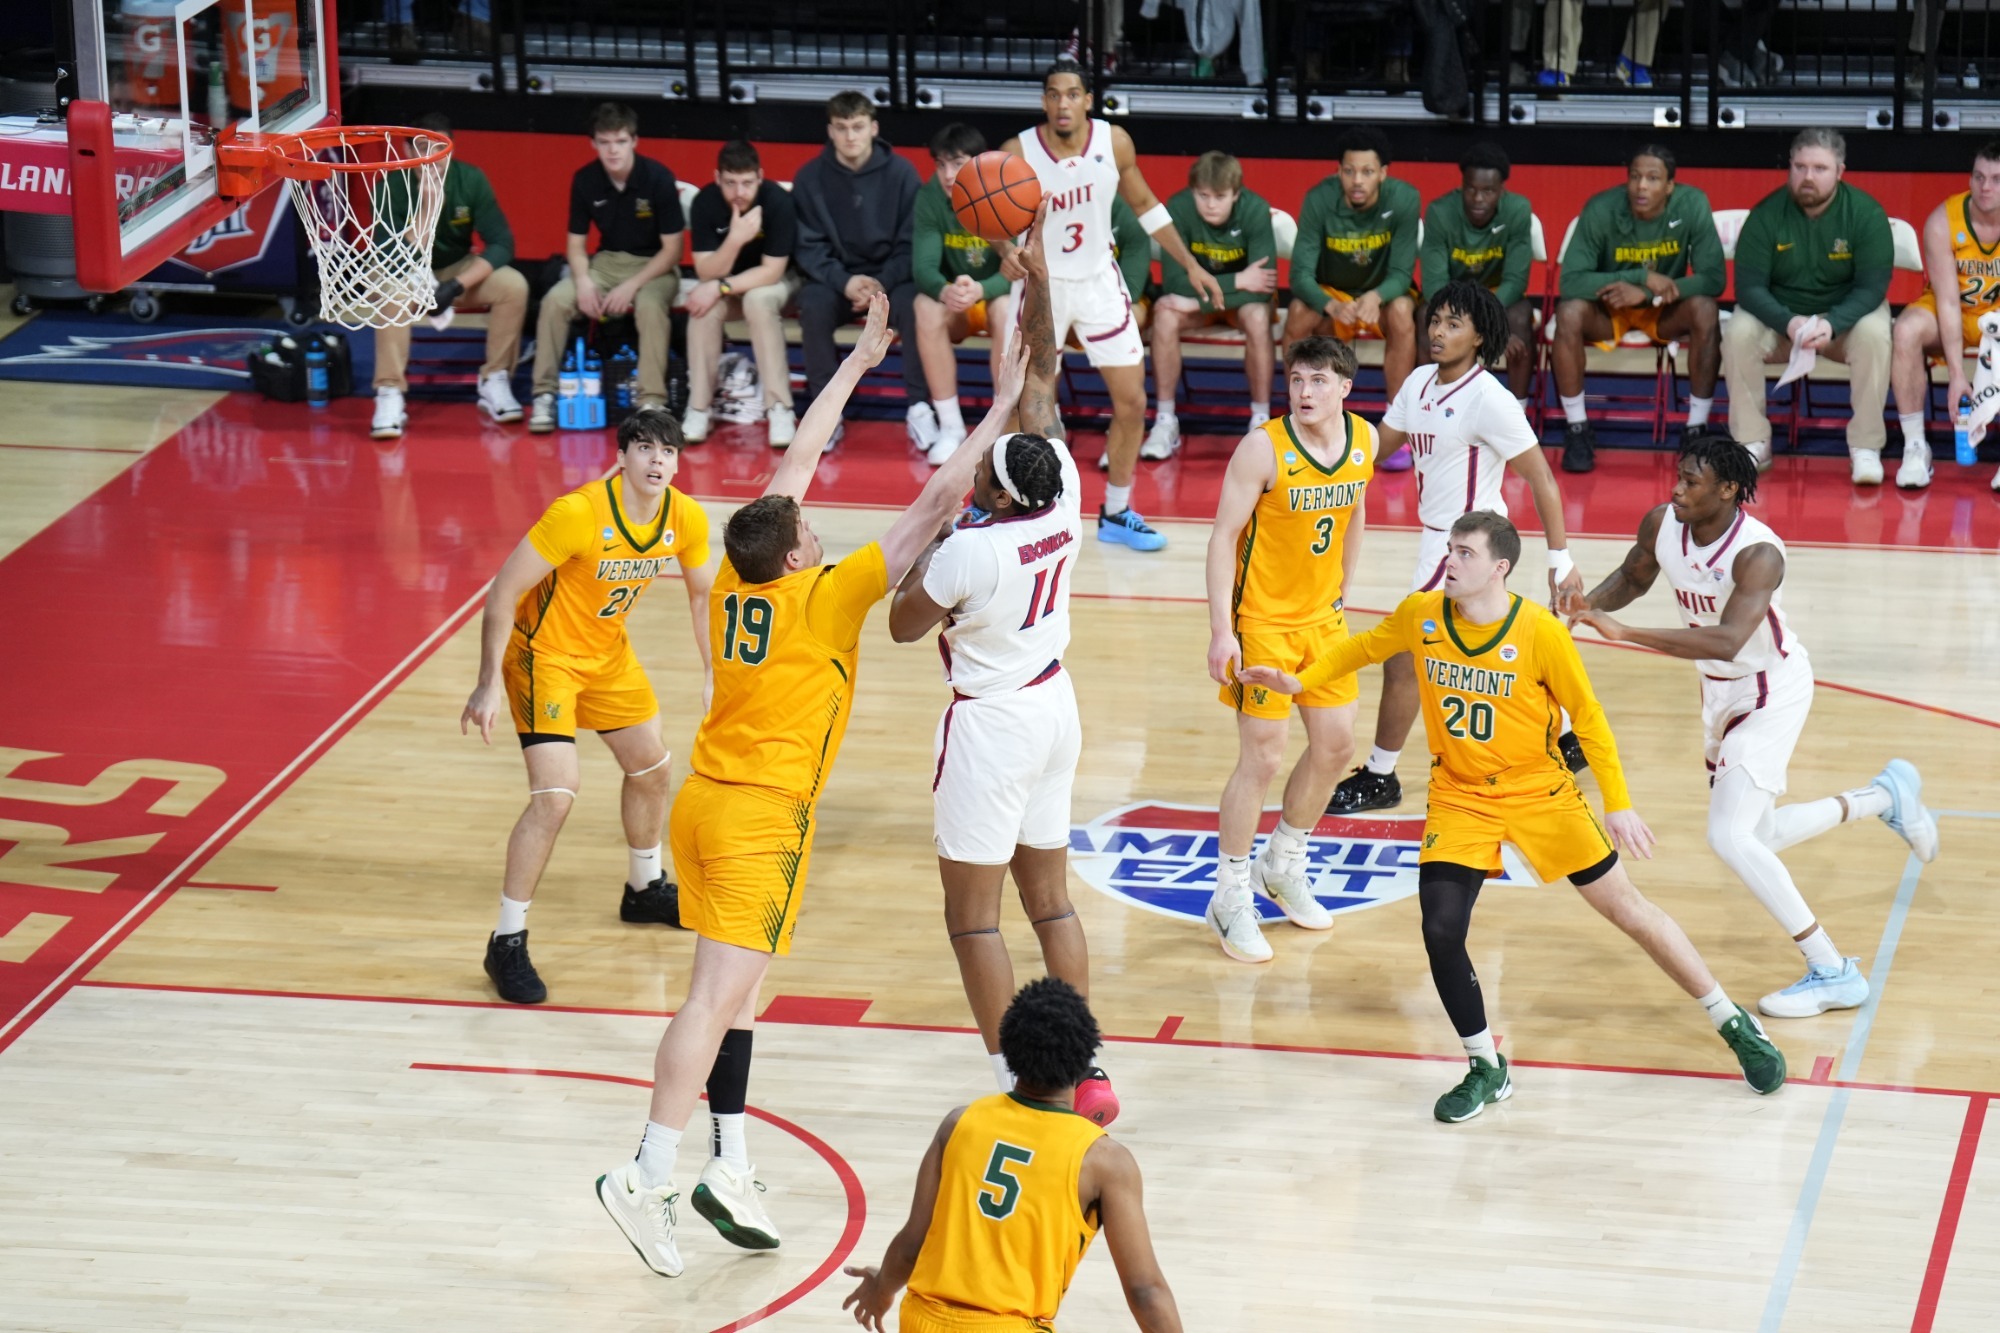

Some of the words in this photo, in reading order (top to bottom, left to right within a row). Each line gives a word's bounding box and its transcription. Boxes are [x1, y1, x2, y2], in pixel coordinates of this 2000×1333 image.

[134, 24, 161, 51] G
[1052, 183, 1094, 212] NJIT
[1062, 222, 1084, 253] 3
[1961, 277, 2000, 306] 24
[1288, 480, 1365, 512] VERMONT
[1311, 515, 1335, 556] 3
[595, 554, 675, 581] VERMONT
[597, 585, 643, 617] 21
[1018, 554, 1068, 631] 11
[1675, 589, 1717, 615] NJIT
[723, 592, 774, 667] 19
[1425, 657, 1516, 698] VERMONT
[1441, 694, 1495, 743] 20
[1109, 858, 1397, 893] EAT
[977, 1139, 1035, 1221] 5
